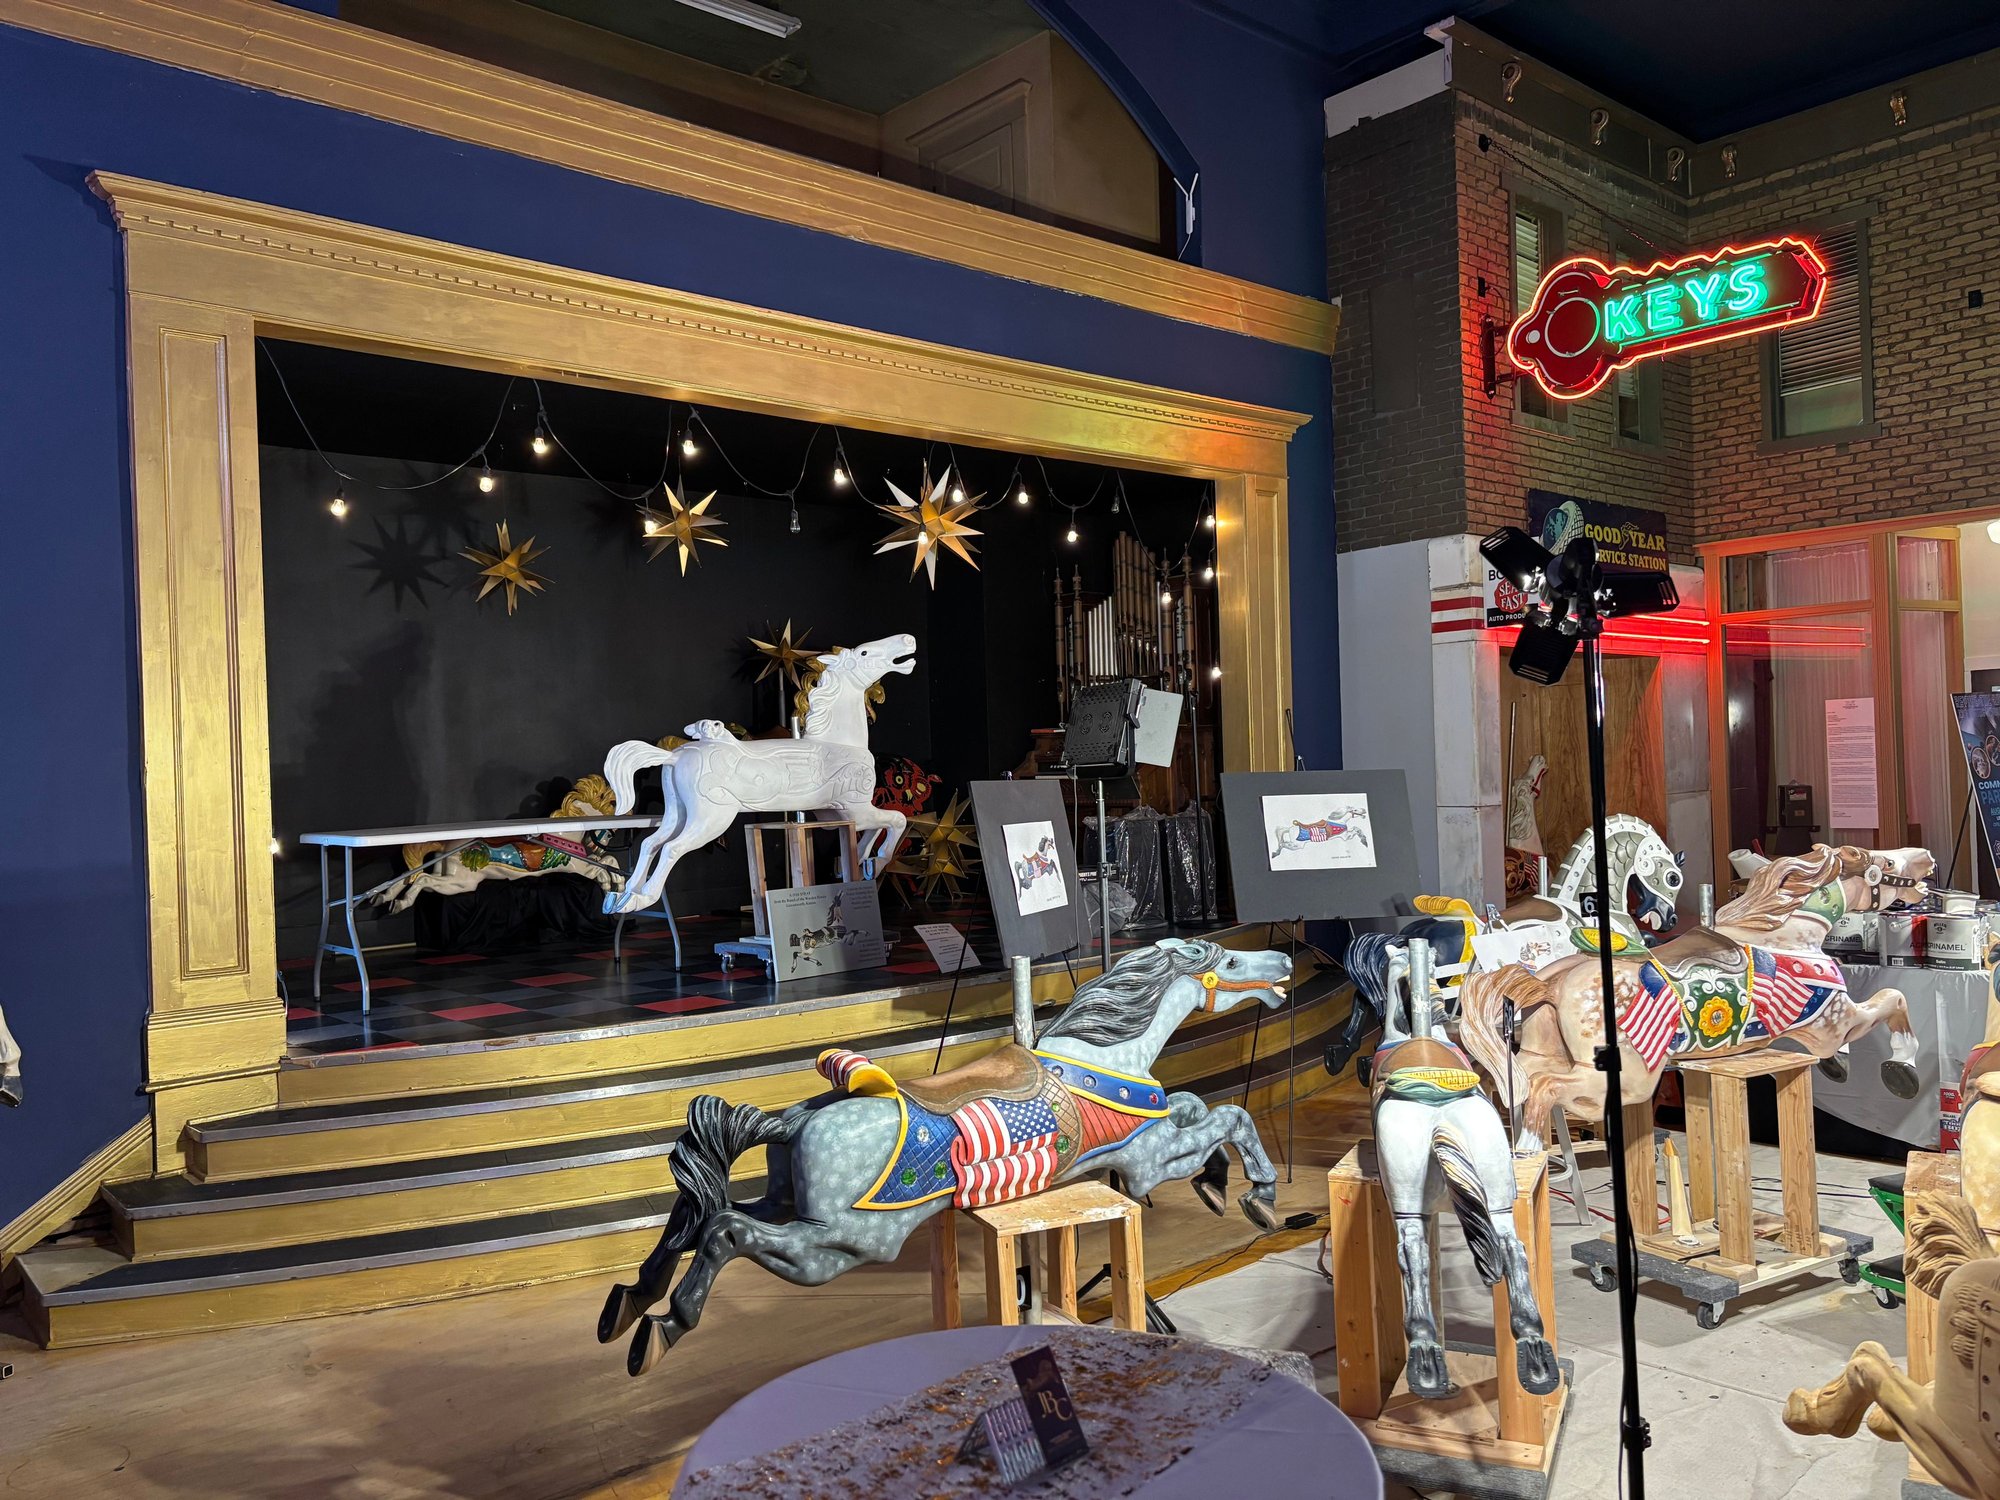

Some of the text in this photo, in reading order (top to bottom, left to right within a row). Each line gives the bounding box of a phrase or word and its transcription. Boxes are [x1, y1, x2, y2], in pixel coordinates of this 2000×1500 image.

[1604, 264, 1768, 344] KEYS
[1599, 549, 1666, 571] RVICE STATION
[1501, 592, 1524, 610] FAST
[1505, 613, 1526, 621] PRODU
